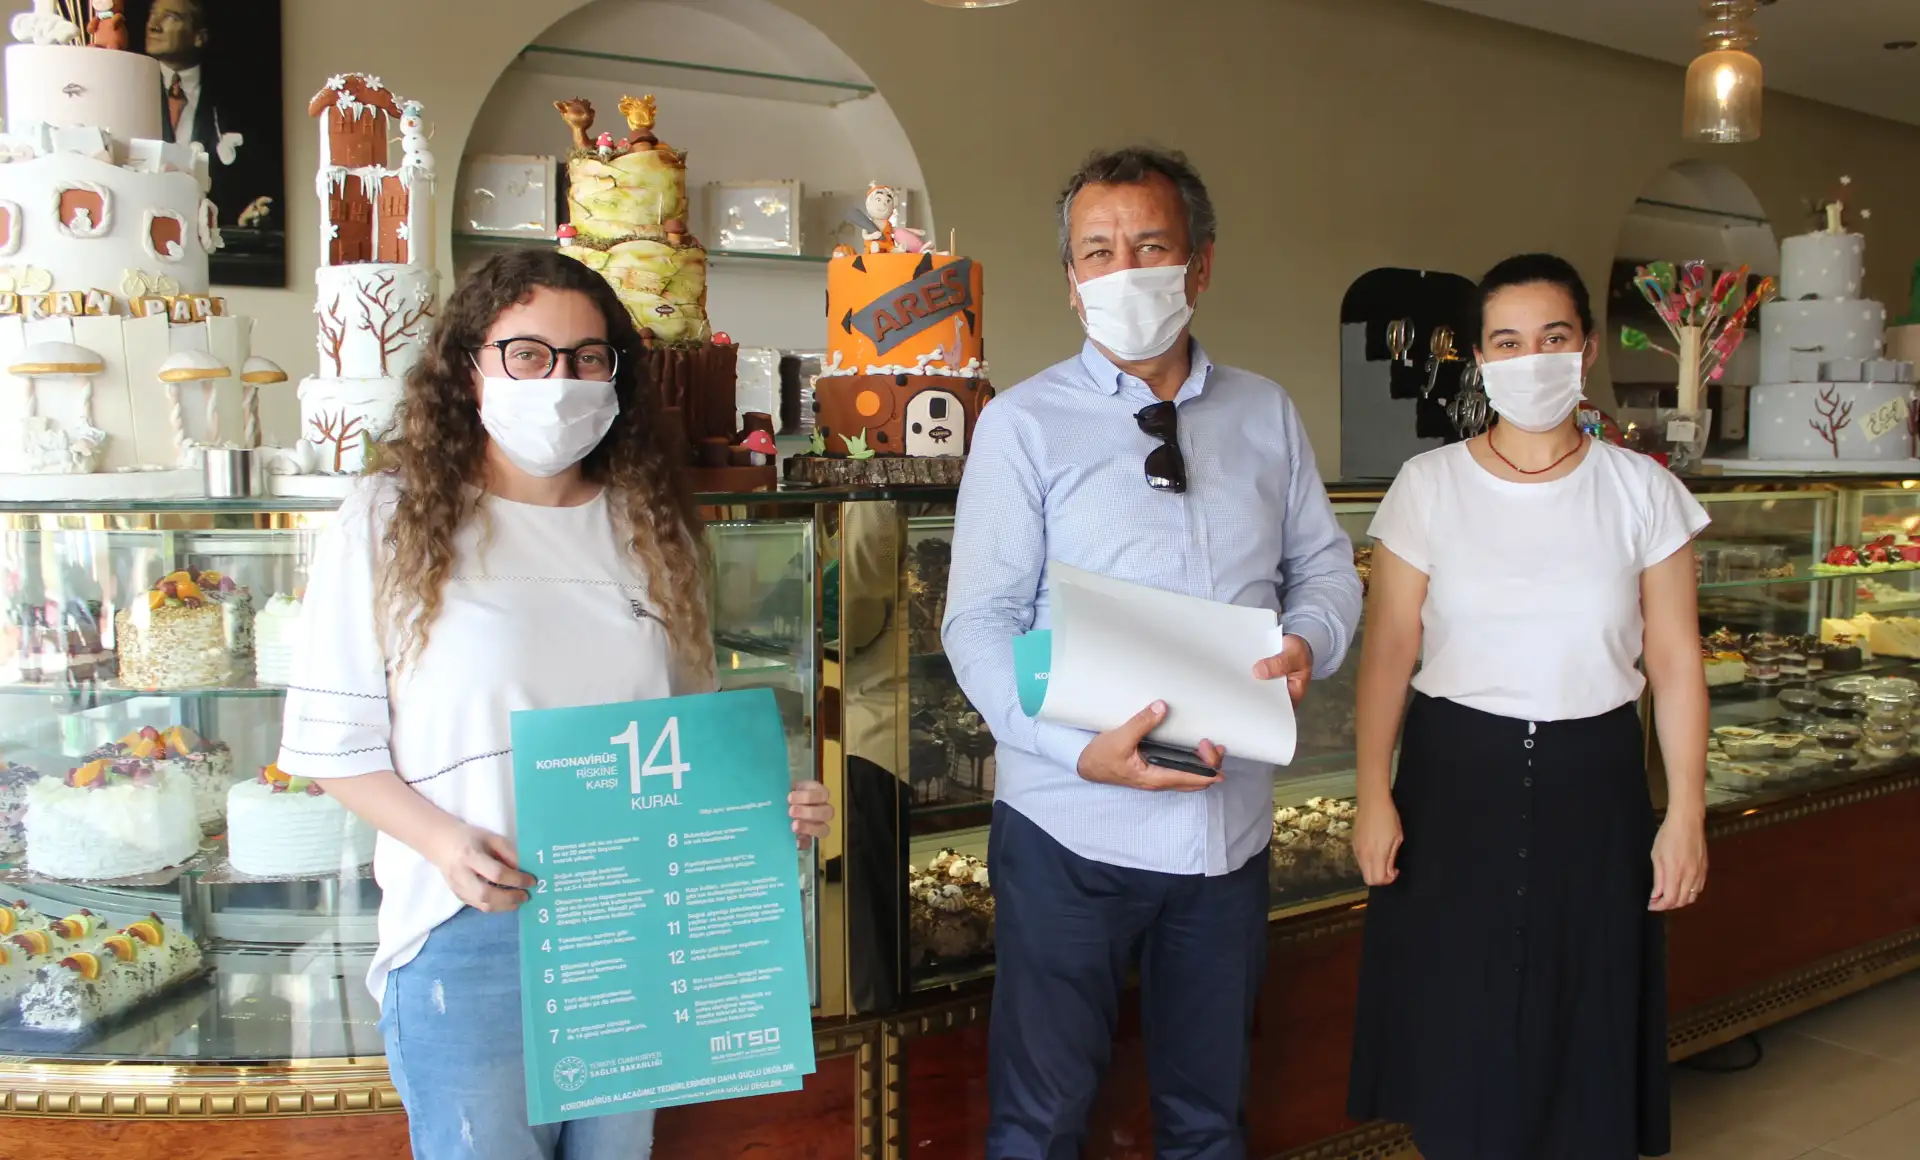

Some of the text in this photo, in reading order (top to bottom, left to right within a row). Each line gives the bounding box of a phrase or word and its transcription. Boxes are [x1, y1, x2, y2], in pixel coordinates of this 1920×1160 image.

[872, 268, 966, 342] ARES
[536, 752, 618, 770] KORONAVİRÜS
[610, 716, 691, 794] 14
[586, 777, 619, 791] KARŞI
[631, 792, 683, 811] KURAL
[667, 833, 679, 848] 8
[536, 849, 544, 864] 1
[668, 862, 679, 876] 9
[536, 879, 548, 894] 2
[663, 890, 680, 906] 10
[538, 908, 550, 924] 3
[667, 920, 681, 936] 11
[541, 938, 552, 953] 4
[668, 949, 685, 965] 12
[544, 968, 555, 984] 5
[670, 979, 688, 995] 13
[546, 998, 558, 1014] 6
[672, 1008, 690, 1024] 14
[549, 1028, 560, 1044] 7
